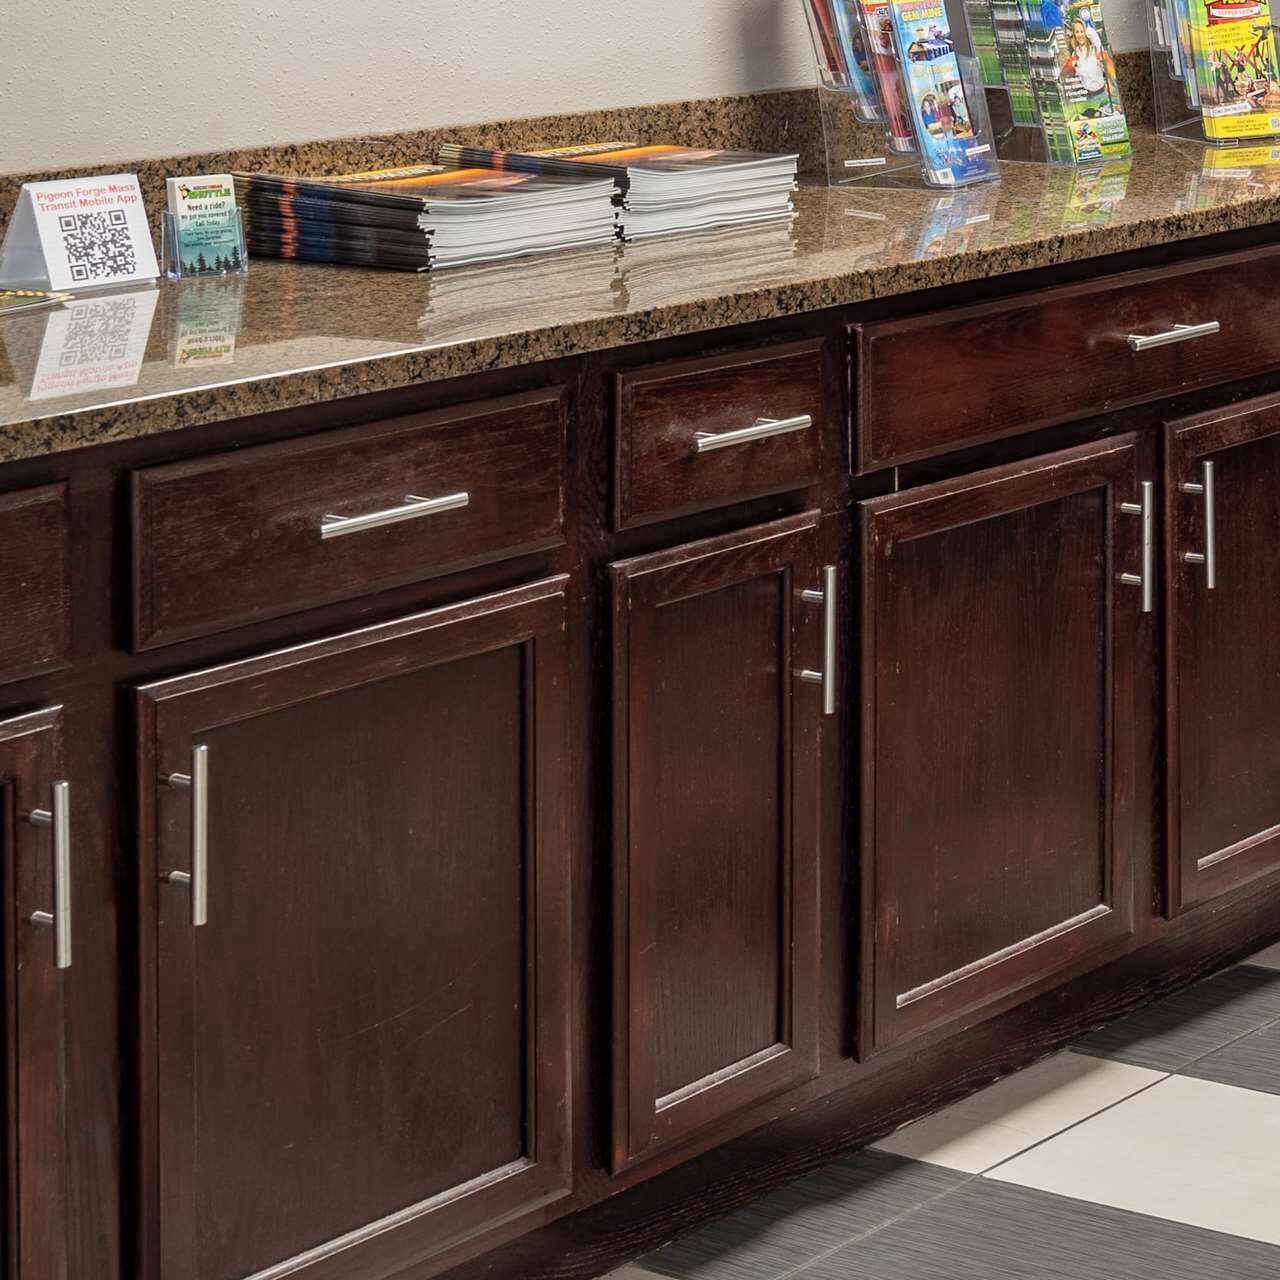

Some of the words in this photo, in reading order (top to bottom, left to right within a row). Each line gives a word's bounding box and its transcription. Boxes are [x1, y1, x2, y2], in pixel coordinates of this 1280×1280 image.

[36, 189, 74, 202] Pigeon
[75, 187, 106, 198] Forge
[108, 183, 135, 193] Mass
[38, 200, 77, 212] Transit
[79, 195, 114, 207] Mobile
[116, 194, 138, 204] App
[187, 203, 202, 211] Need
[209, 200, 226, 210] ride?
